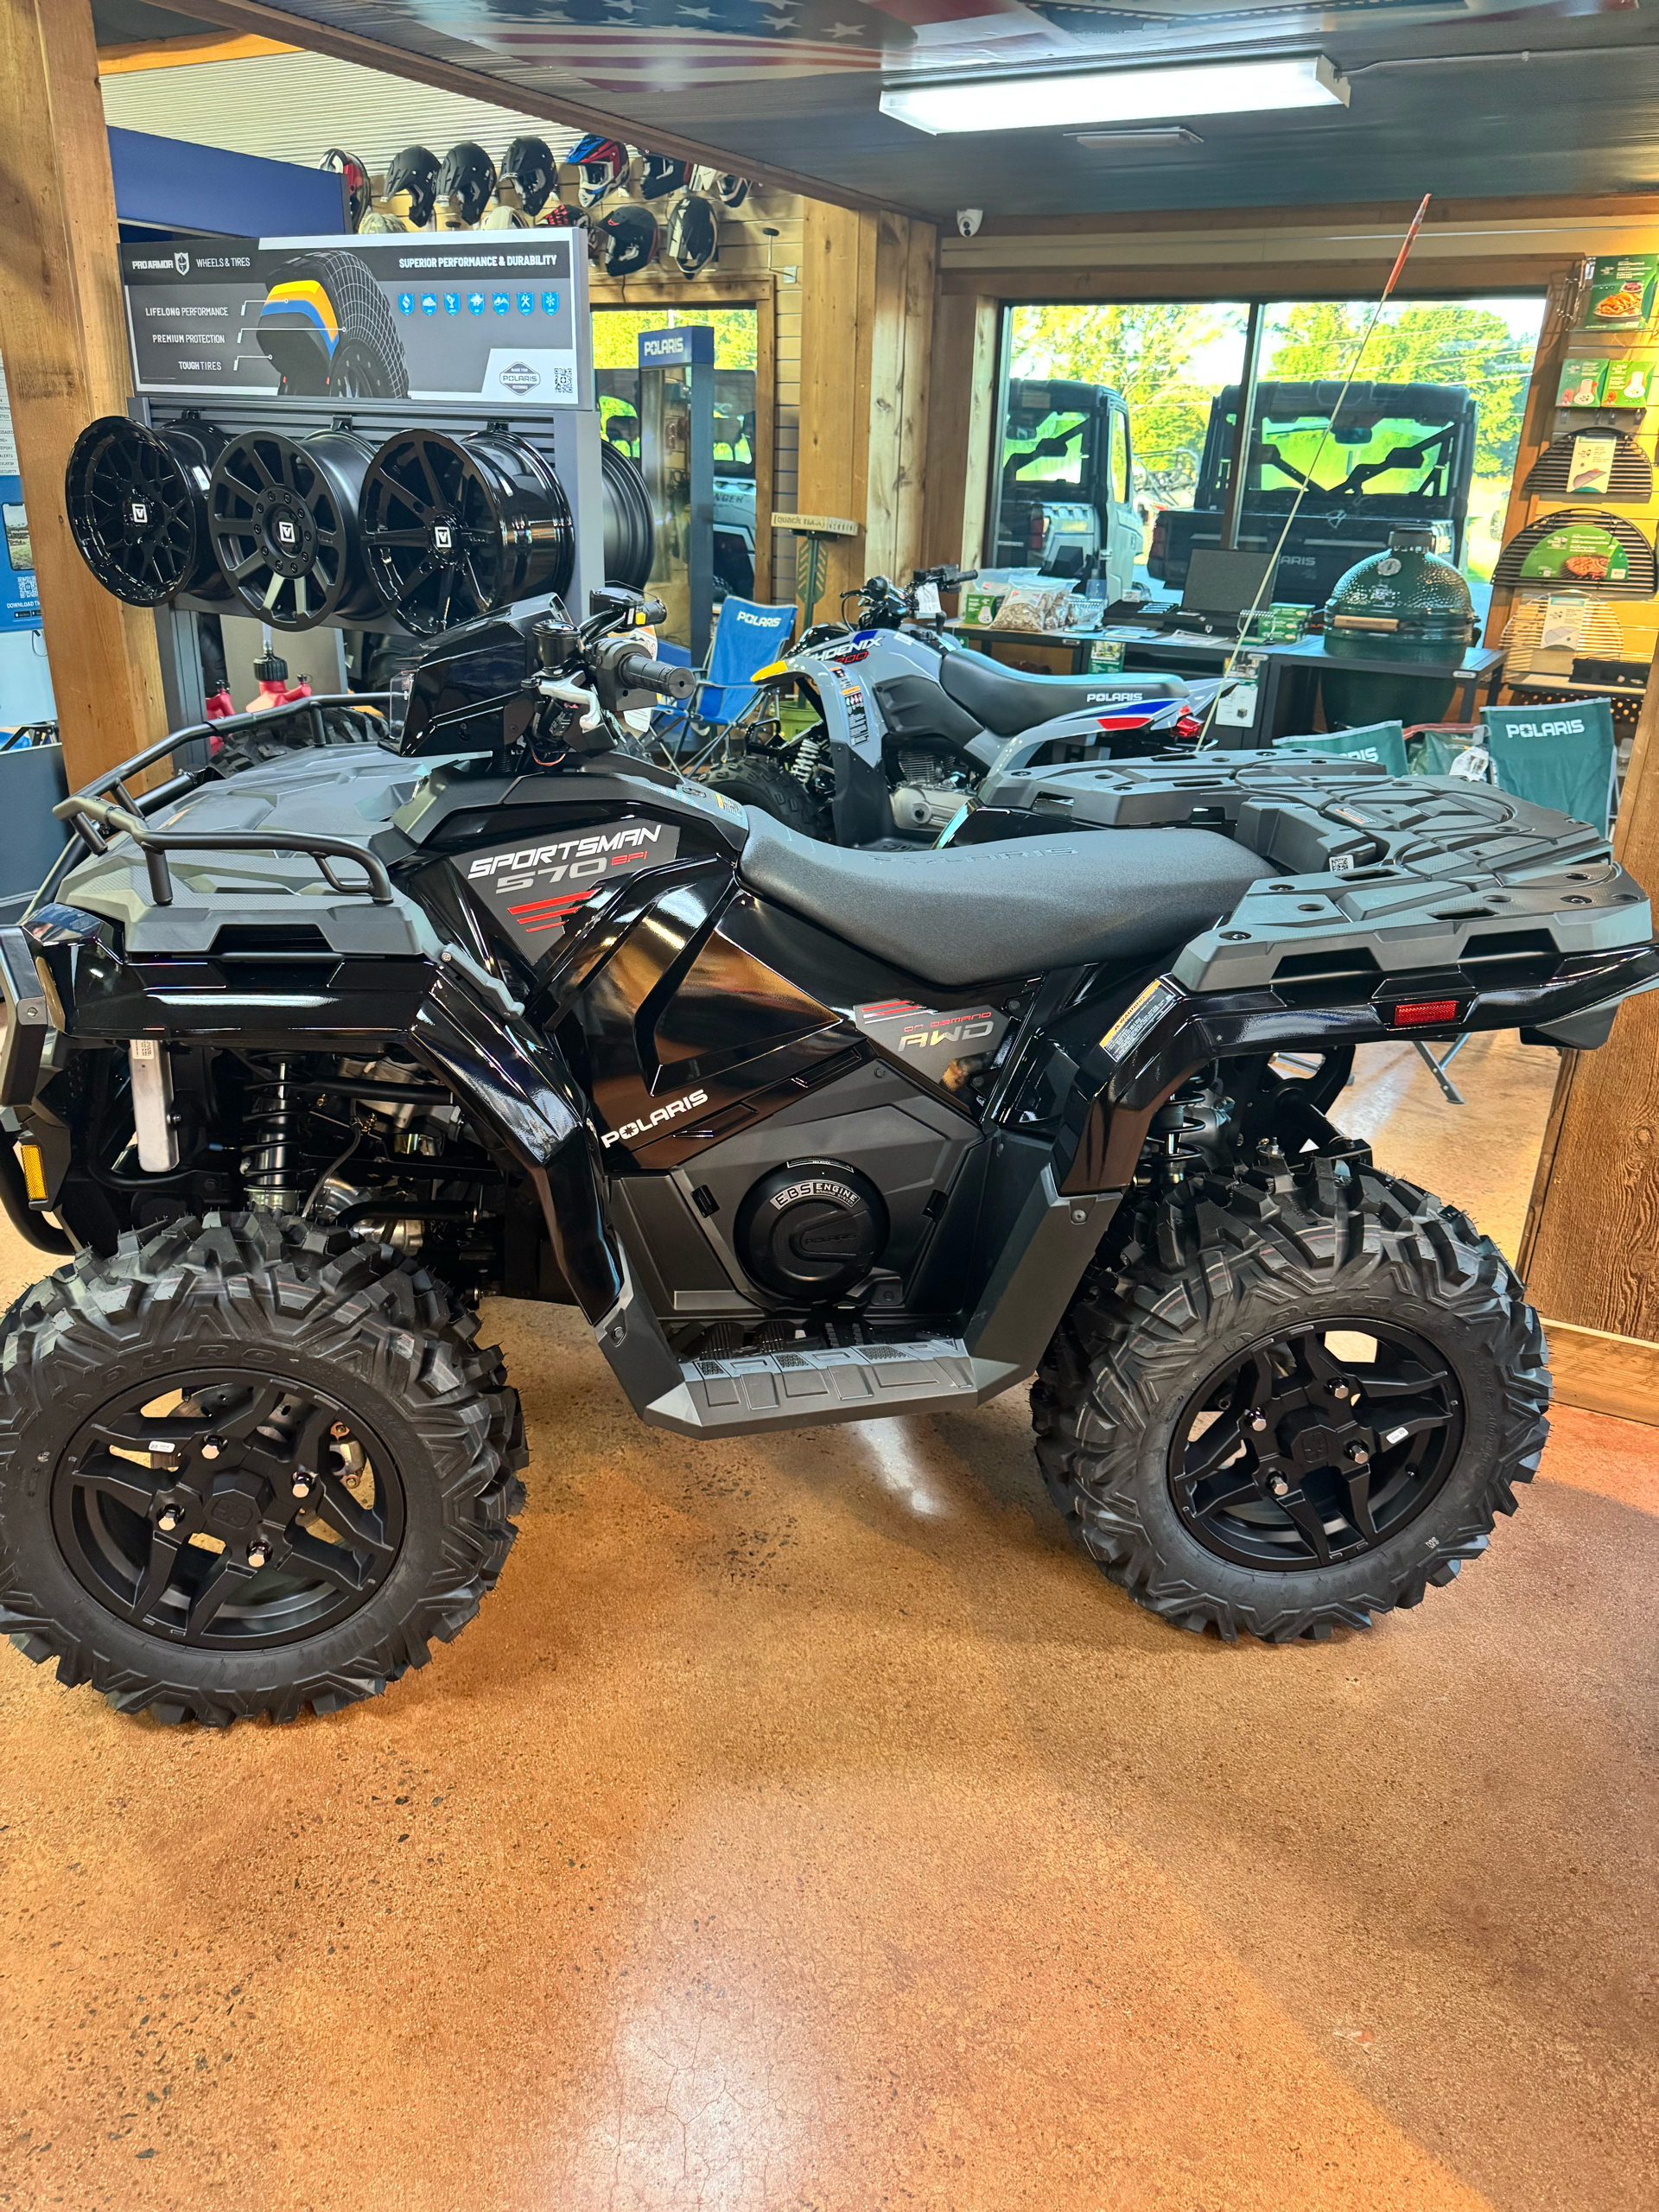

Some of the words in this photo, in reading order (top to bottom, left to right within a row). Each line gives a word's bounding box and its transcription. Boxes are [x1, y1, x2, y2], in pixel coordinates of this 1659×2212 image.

[196, 258, 224, 268] WHEELS
[225, 258, 230, 267] &
[230, 257, 251, 267] TIRES
[399, 257, 438, 268] SUPERIOR
[438, 256, 498, 268] PERFORMANCE
[499, 256, 505, 267] &
[507, 254, 557, 266] DURABILITY
[145, 307, 180, 316] LIFELONG
[181, 307, 229, 316] PERFORMANCE
[152, 334, 184, 343] PREMIUM
[186, 334, 225, 343] PROTECTION
[644, 337, 683, 356] POLARIS
[178, 361, 200, 370] TOUGH
[200, 361, 222, 370] TIRES
[737, 611, 781, 627] POLARIS
[1087, 693, 1143, 702] POLARIS
[1505, 719, 1585, 739] POLARIS
[467, 824, 662, 880] SPORTSMAN
[496, 857, 607, 894] 570
[1119, 995, 1145, 1023] WARNING
[898, 1021, 994, 1052] AWD
[601, 1089, 708, 1148] POLARIS
[775, 1183, 811, 1206] EBS
[816, 1183, 857, 1202] ENGINE
[838, 1194, 853, 1205] SYSTEM
[805, 1232, 856, 1245] POLARIS
